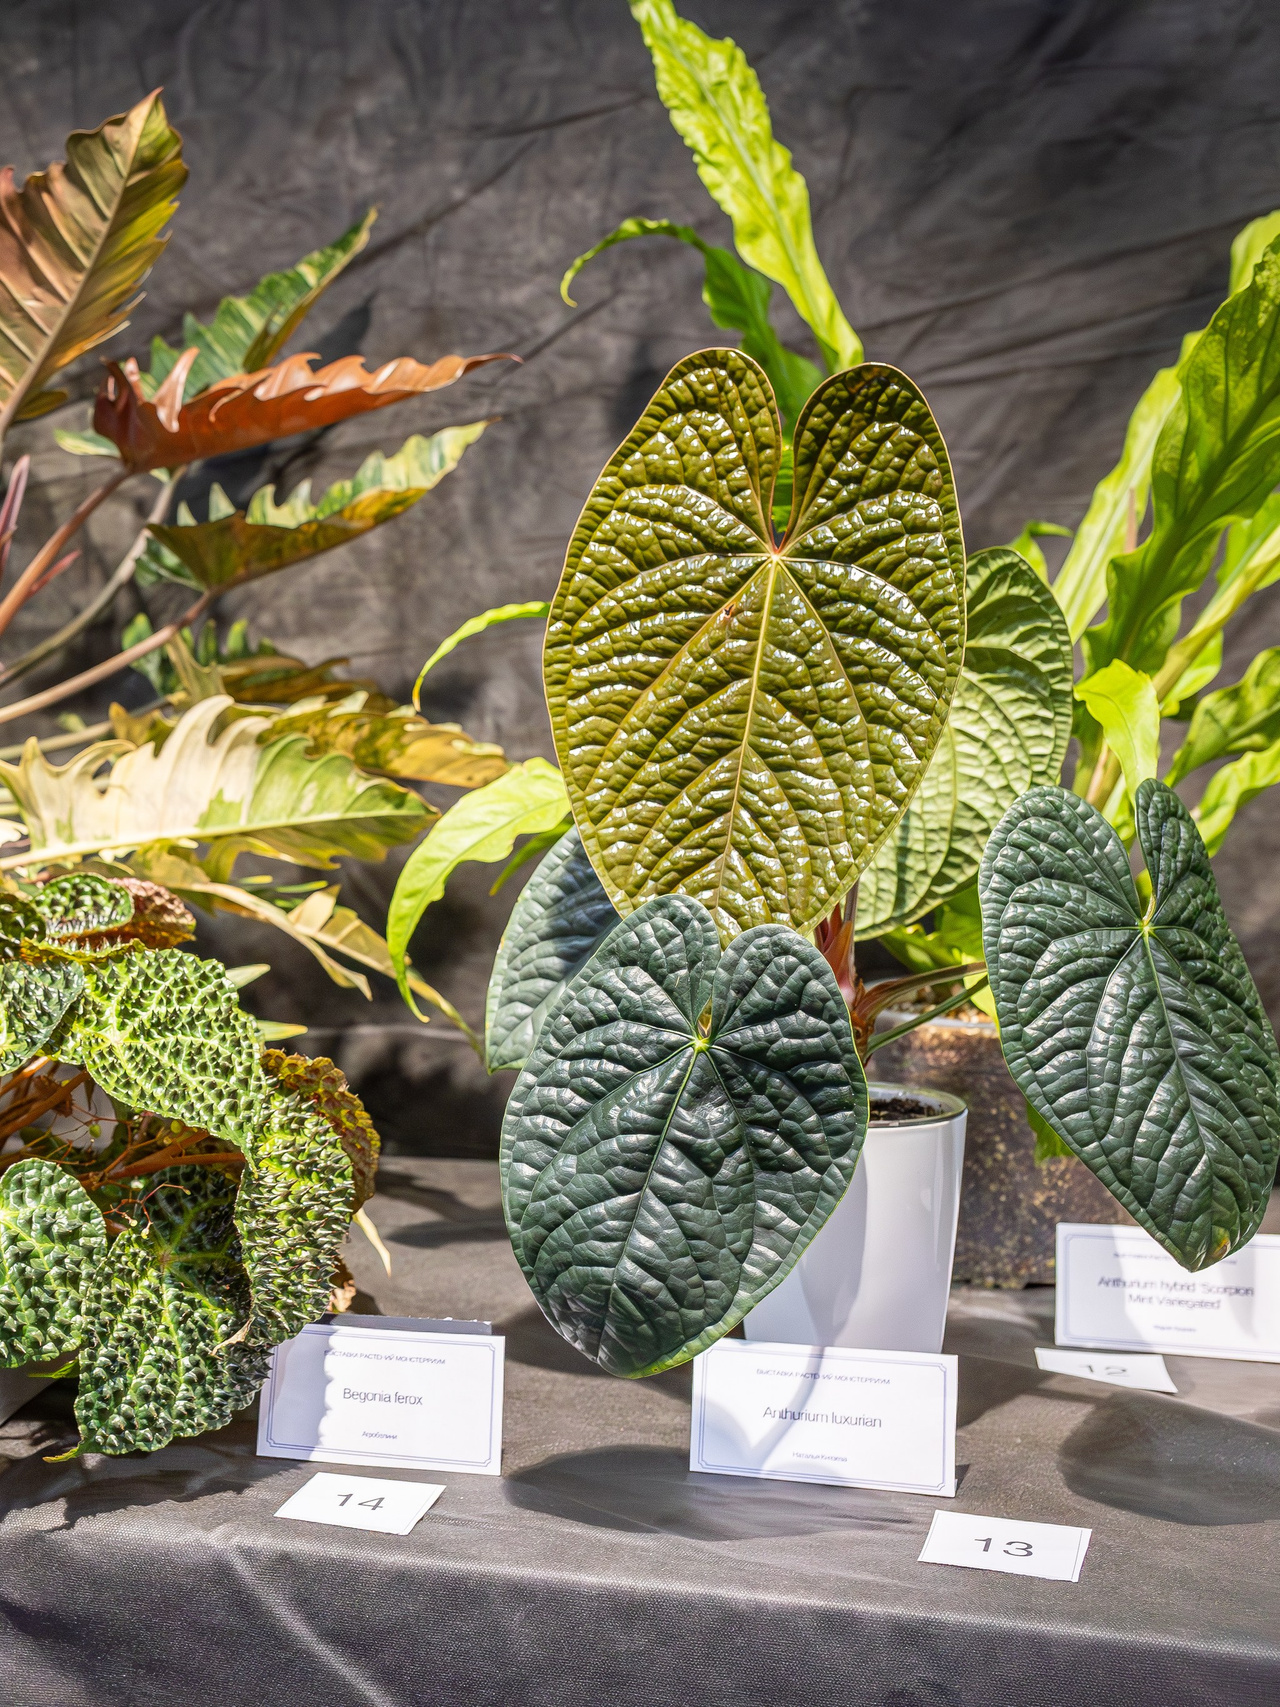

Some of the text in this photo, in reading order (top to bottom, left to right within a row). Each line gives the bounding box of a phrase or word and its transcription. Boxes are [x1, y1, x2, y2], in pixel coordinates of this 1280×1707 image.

[1160, 1280, 1197, 1293] hybrid
[1129, 1293, 1153, 1304] Mint
[1079, 1364, 1130, 1377] 12
[343, 1387, 423, 1406] Begonia ferox
[762, 1406, 882, 1428] Anthurium luxurian
[337, 1493, 386, 1511] 14
[974, 1537, 1034, 1557] 13
